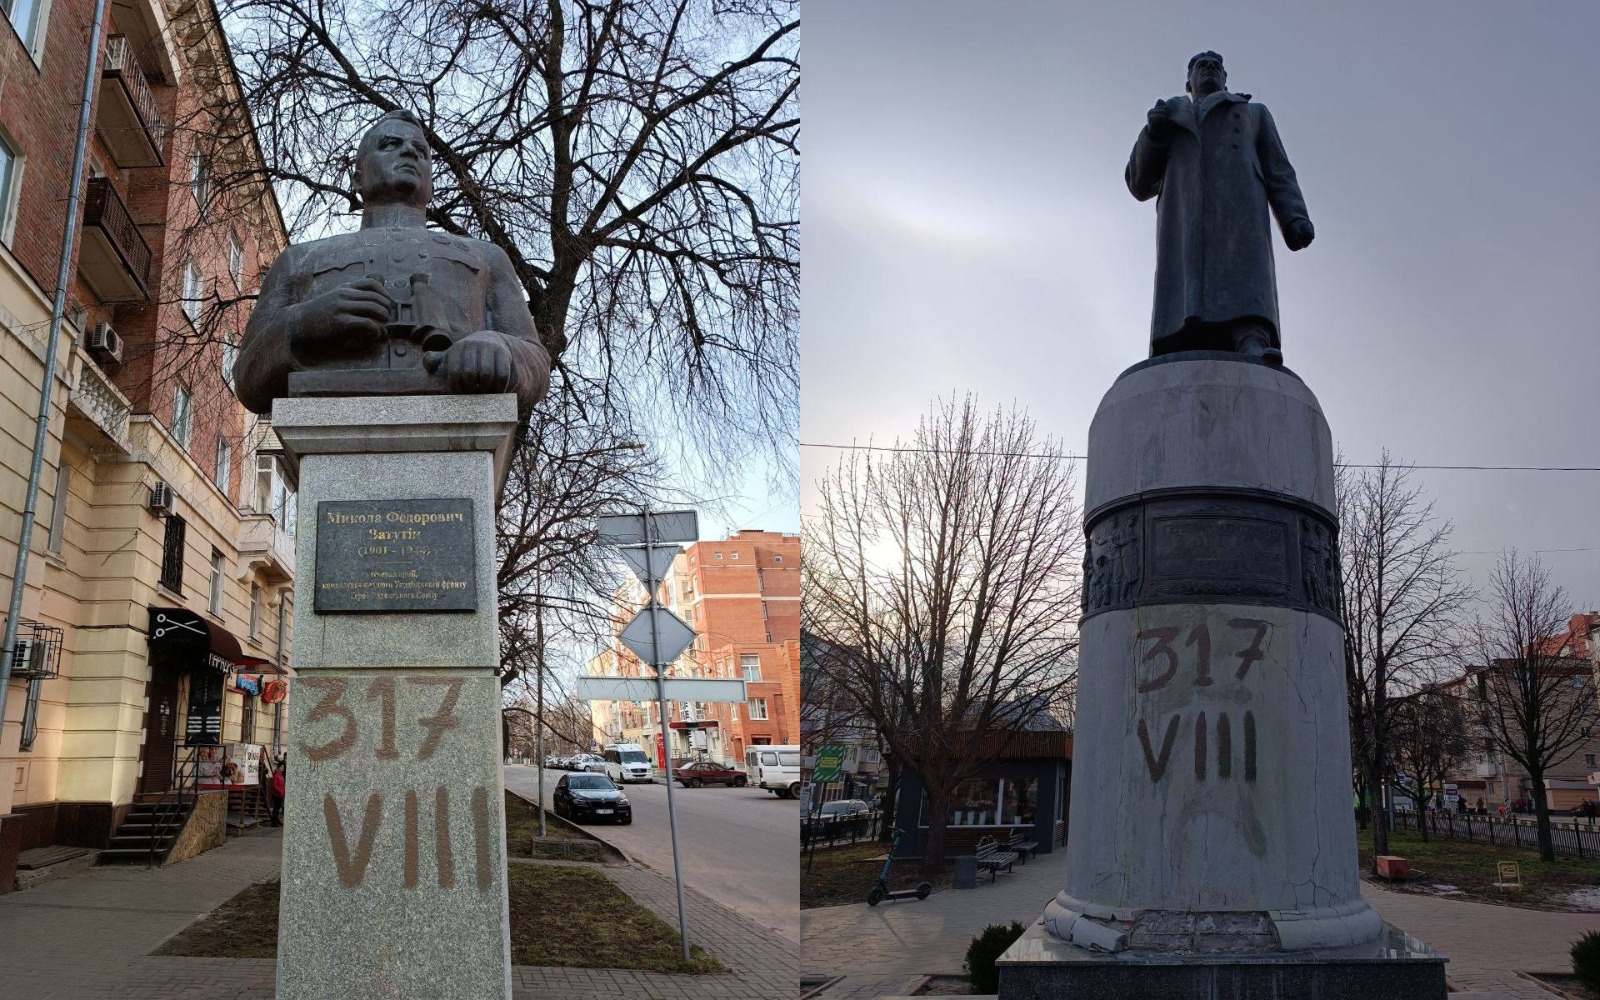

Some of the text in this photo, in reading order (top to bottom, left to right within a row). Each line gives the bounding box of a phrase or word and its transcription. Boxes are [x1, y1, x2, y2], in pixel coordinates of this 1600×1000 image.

[327, 511, 464, 526] Микола Федорович
[1138, 618, 1267, 693] 317
[297, 677, 464, 763] 317
[1137, 710, 1257, 783] VIII
[323, 787, 491, 893] VIII
